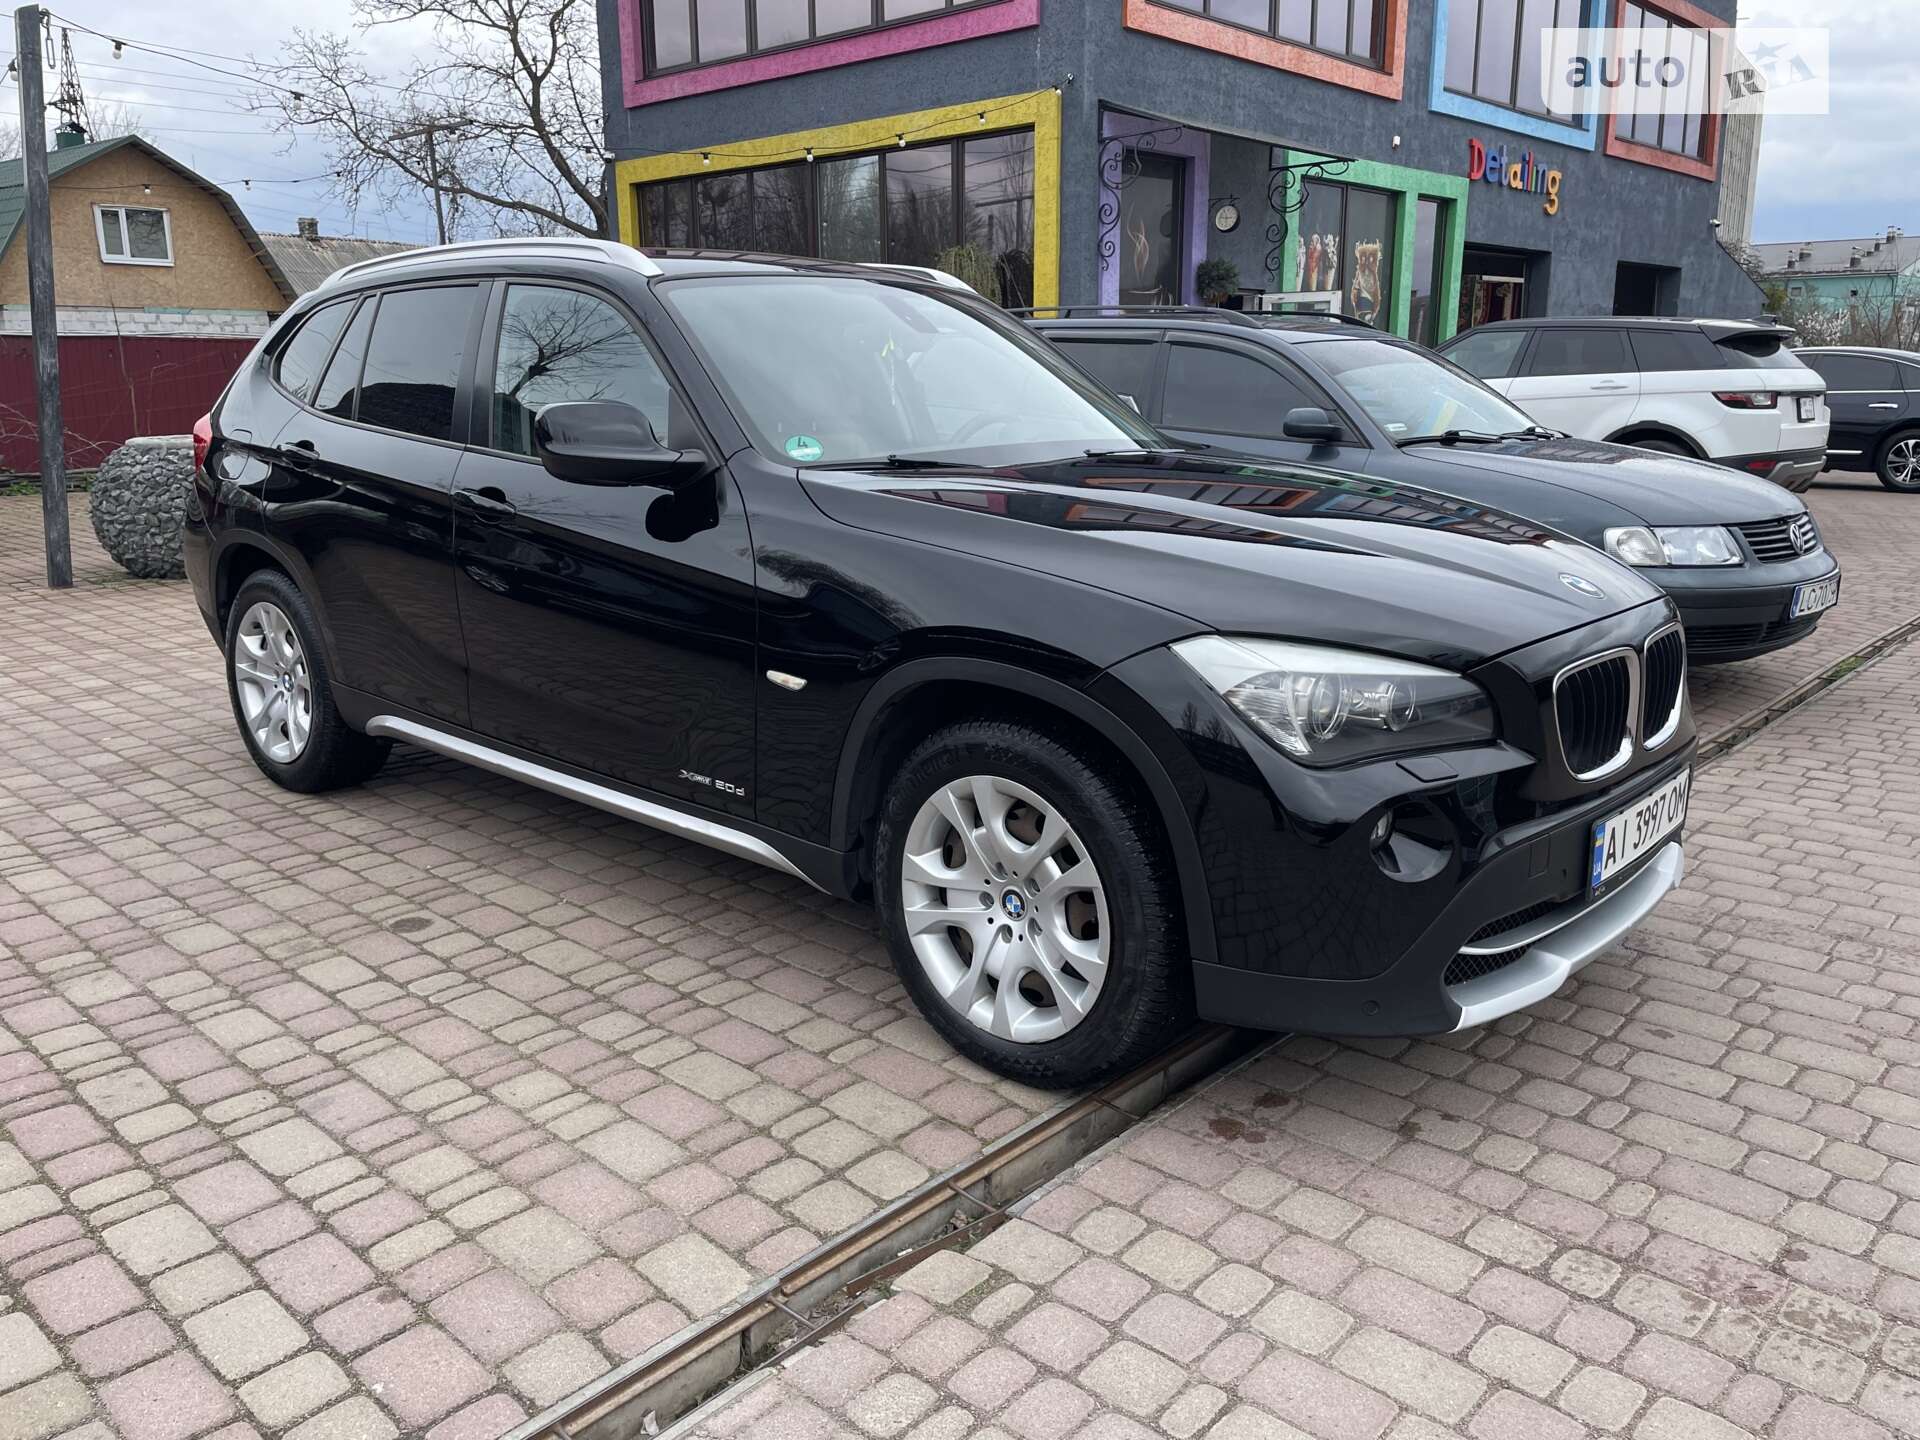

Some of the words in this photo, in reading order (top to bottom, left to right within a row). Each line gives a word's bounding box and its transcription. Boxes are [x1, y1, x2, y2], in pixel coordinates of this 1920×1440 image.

[1468, 137, 1562, 215] Detailing
[715, 779, 745, 796] 20d
[1604, 819, 1627, 870] AI
[1633, 793, 1667, 850] 3997
[1667, 776, 1688, 823] OM
